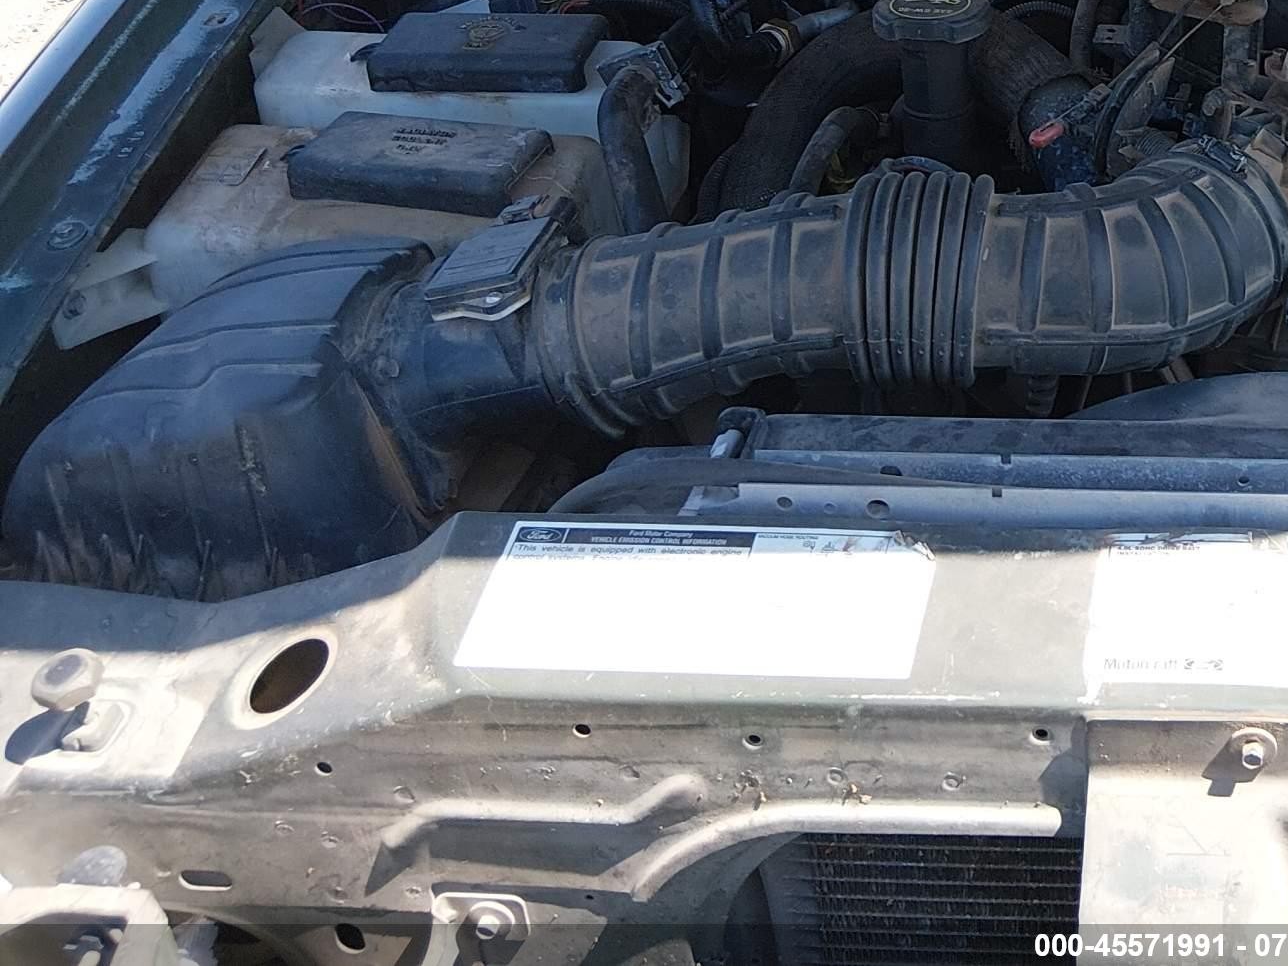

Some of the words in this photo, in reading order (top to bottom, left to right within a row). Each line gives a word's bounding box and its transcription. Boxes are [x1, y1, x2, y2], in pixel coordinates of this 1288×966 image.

[527, 529, 554, 540] Ford
[663, 531, 694, 539] Company
[682, 538, 728, 546] INFORMATION
[518, 544, 537, 552] This
[542, 545, 574, 553] vehicle
[590, 546, 634, 556] equipped
[638, 546, 657, 554] with
[660, 547, 707, 555] electronic
[710, 548, 743, 557] engine
